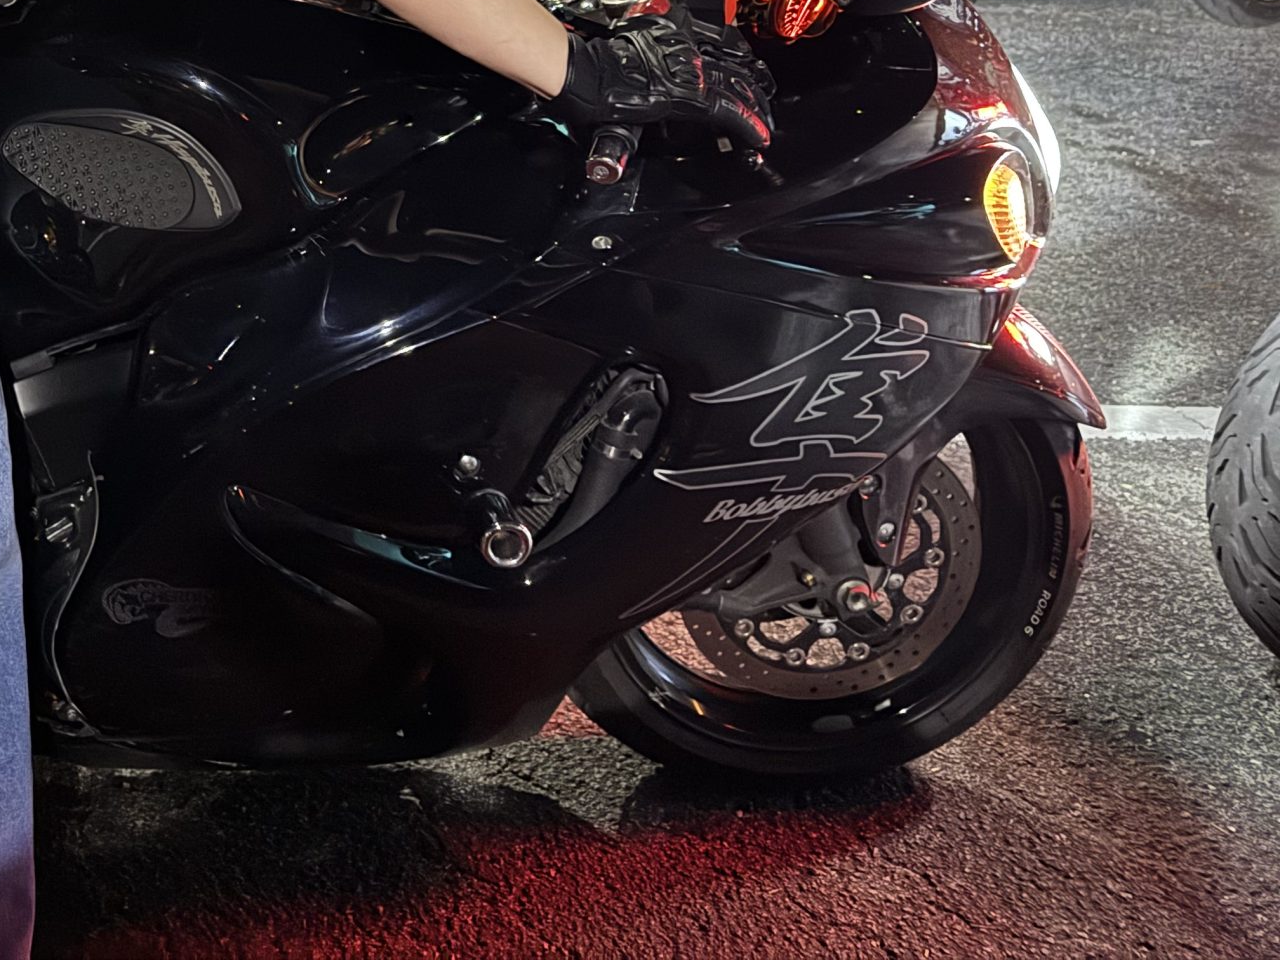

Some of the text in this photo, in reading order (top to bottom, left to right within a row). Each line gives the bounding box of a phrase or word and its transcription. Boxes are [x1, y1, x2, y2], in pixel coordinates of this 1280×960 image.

[1023, 512, 1064, 637] MICHELIN ROAD 6
